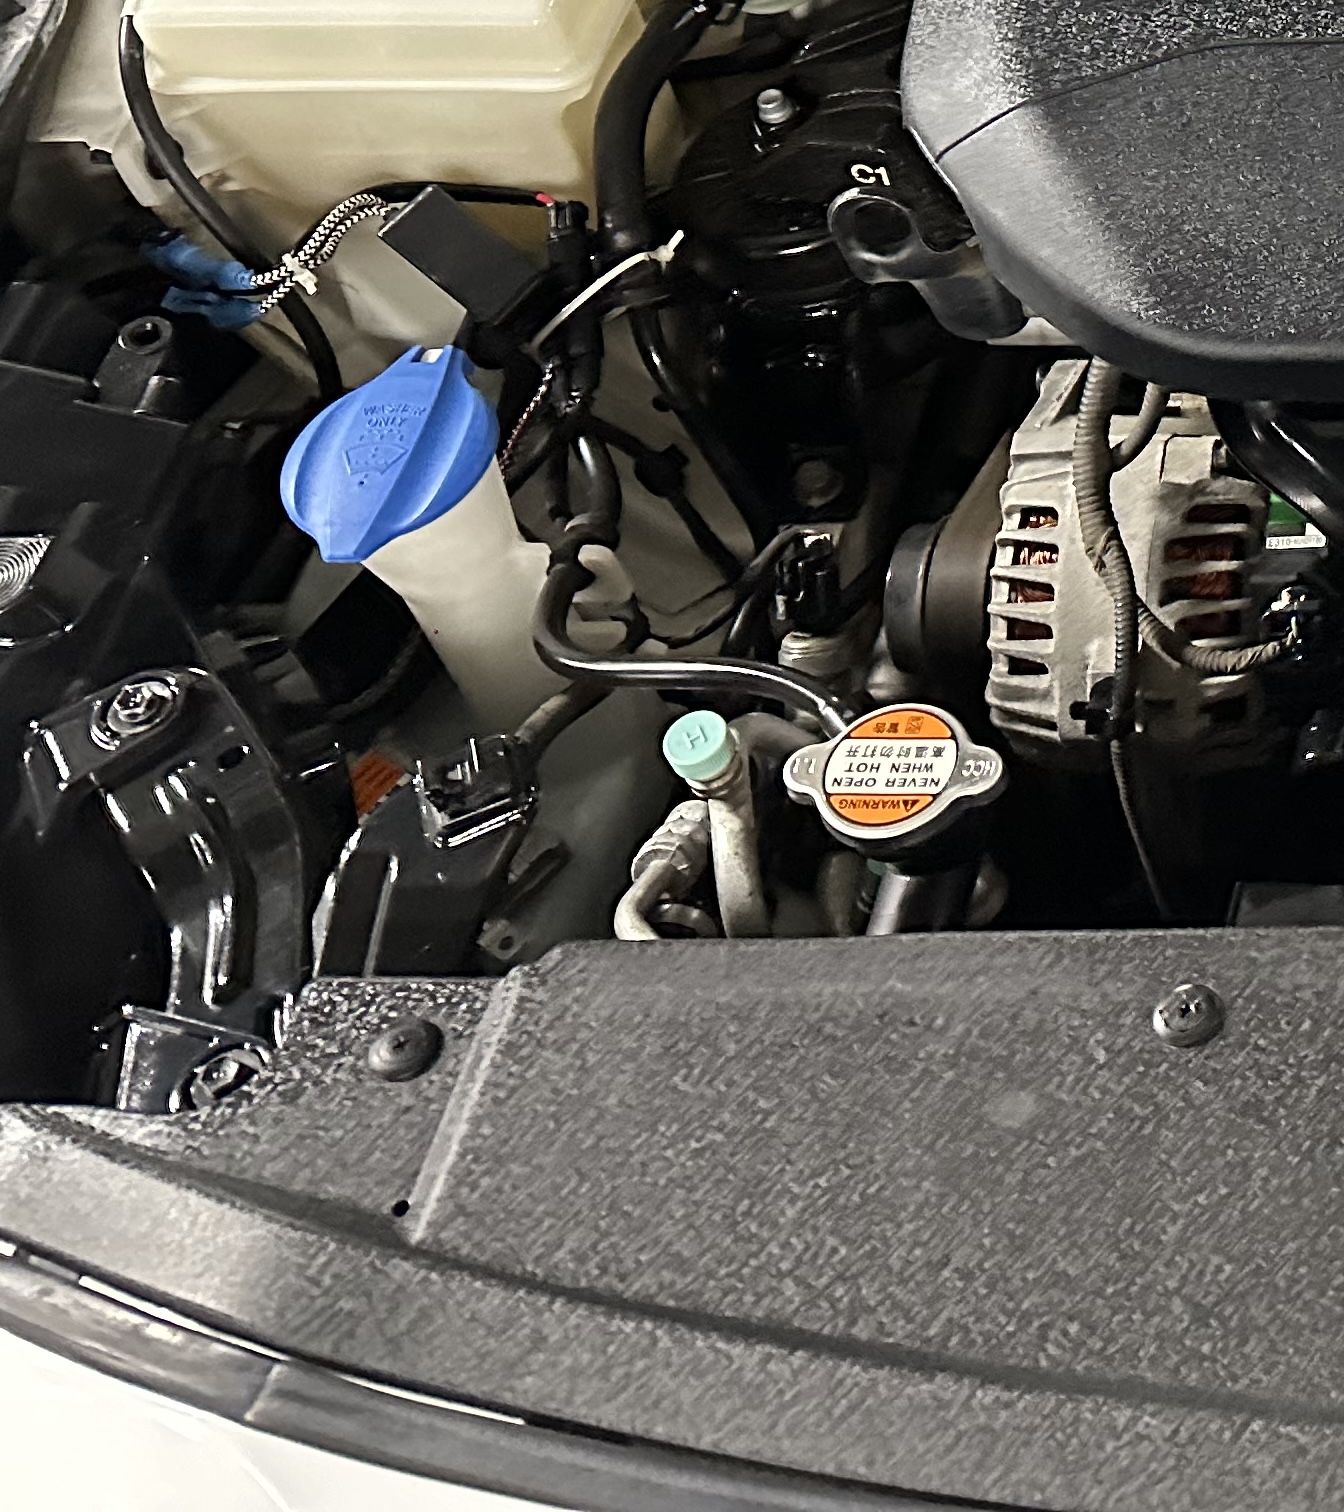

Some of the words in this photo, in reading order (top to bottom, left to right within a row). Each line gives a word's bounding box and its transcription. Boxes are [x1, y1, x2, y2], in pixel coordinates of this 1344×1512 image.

[850, 163, 891, 186] C1
[366, 416, 409, 428] ONLY
[684, 724, 709, 750] H
[845, 745, 946, 758] 高温时勿打开
[843, 762, 881, 773] HOT
[890, 762, 934, 773] WHEN
[831, 776, 877, 788] OPEN
[885, 776, 941, 788] NEVER
[838, 797, 902, 810] WARNING
